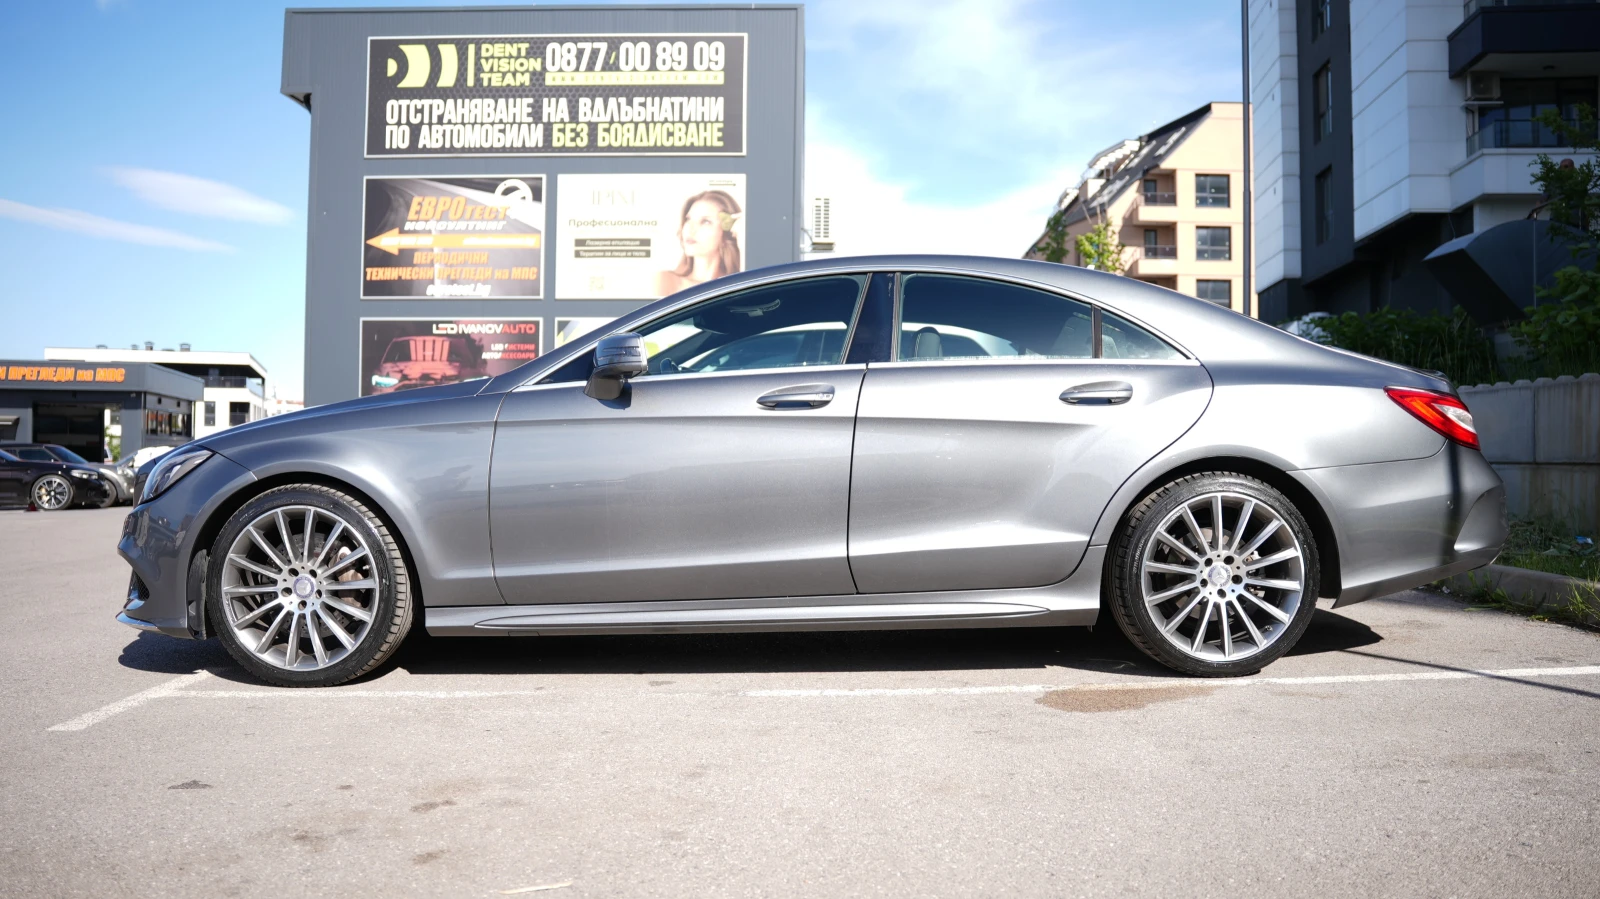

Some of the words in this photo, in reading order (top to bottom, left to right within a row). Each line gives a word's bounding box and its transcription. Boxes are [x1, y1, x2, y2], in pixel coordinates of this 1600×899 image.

[480, 43, 529, 57] DENT
[655, 42, 688, 72] 89
[693, 41, 725, 72] 09
[480, 57, 542, 71] VISION
[480, 72, 530, 87] TEAM
[385, 98, 533, 124] ОТСТРАНЯВАНЕ
[542, 98, 570, 123] НА
[578, 97, 724, 122] ВДЛЪБНАТИНИ
[385, 125, 410, 149] ПО
[418, 124, 543, 148] АВТОМОБИЛИ
[552, 123, 589, 147] БЕЗ
[597, 122, 724, 147] БОЯДИСВАНЕ
[568, 218, 658, 228] Професионална
[413, 252, 490, 265] ПЕРИОДИЧНИ
[366, 267, 434, 281] ТЕХНИЧЕСКИ
[437, 267, 492, 281] ПРЕГЛЕДИ
[494, 269, 510, 280] на
[511, 267, 538, 280] МПС
[432, 324, 457, 335] LED
[8, 366, 75, 382] ПРЕГЛЕДИ
[76, 369, 94, 381] на
[95, 367, 126, 383] МПС
